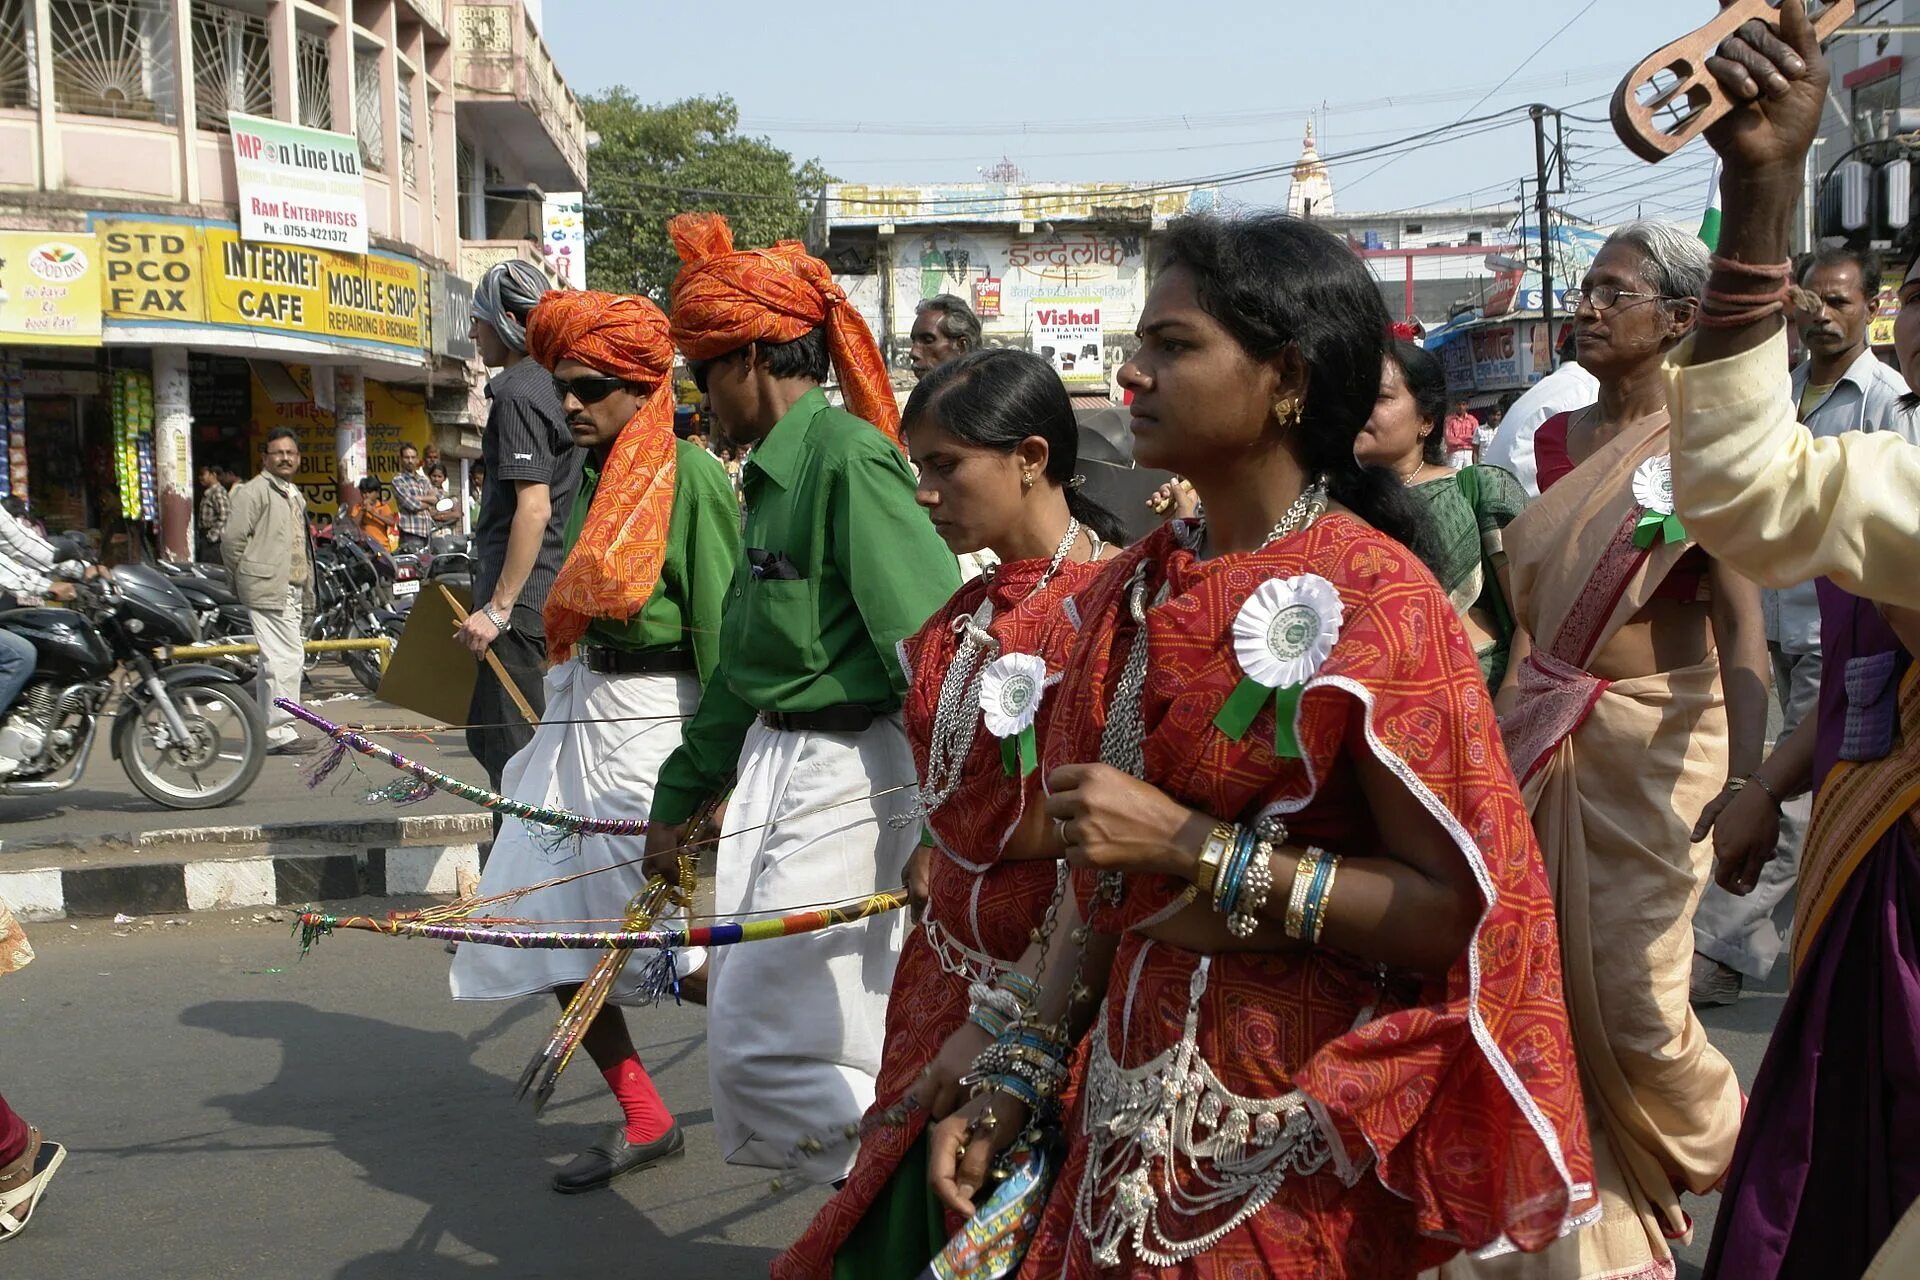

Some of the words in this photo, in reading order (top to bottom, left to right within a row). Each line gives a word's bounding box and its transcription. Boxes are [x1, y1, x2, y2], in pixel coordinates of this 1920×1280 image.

[293, 143, 328, 170] Line
[331, 149, 360, 176] Ltd.
[107, 233, 185, 254] STD
[108, 260, 191, 282] PCO
[222, 241, 319, 288] INTERNET
[112, 288, 187, 312] FAX
[238, 289, 303, 324] CAFE
[327, 271, 384, 314] MOBILE
[387, 283, 416, 318] SHOP
[328, 312, 378, 335] REPAIRING
[379, 319, 385, 336] &
[386, 321, 417, 342] RECHARGE
[1037, 309, 1100, 325] Vishal
[300, 456, 334, 473] BILE
